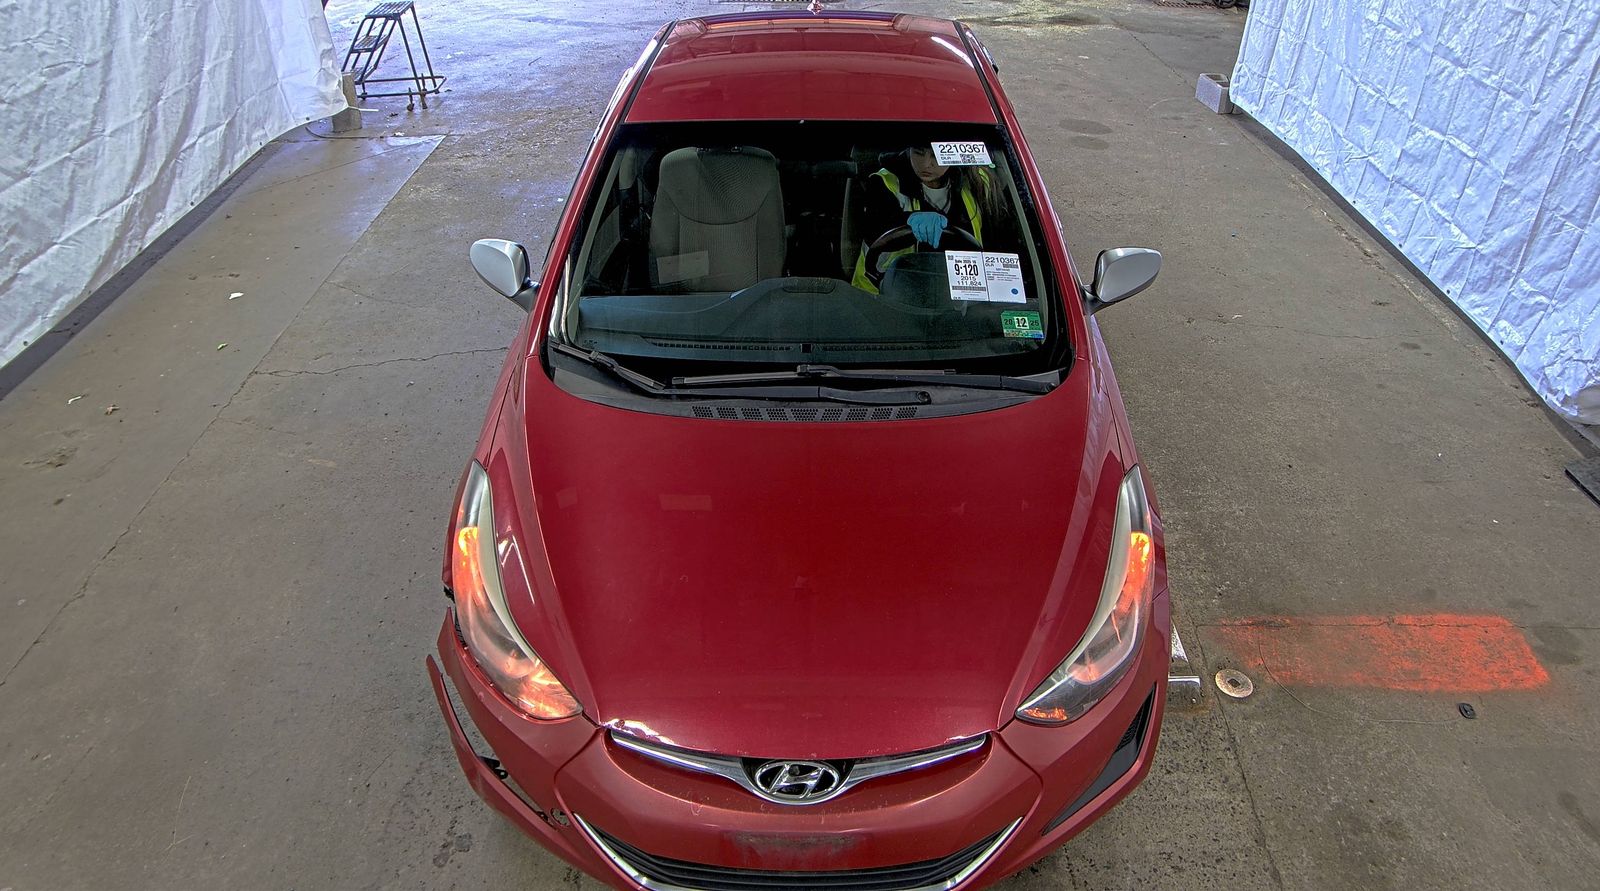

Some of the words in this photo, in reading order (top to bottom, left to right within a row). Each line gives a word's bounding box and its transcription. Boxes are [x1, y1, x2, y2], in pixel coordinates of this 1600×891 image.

[938, 144, 985, 153] 2210367
[985, 256, 1019, 264] 2210367
[954, 263, 979, 276] 9:120
[1016, 317, 1028, 328] 12
